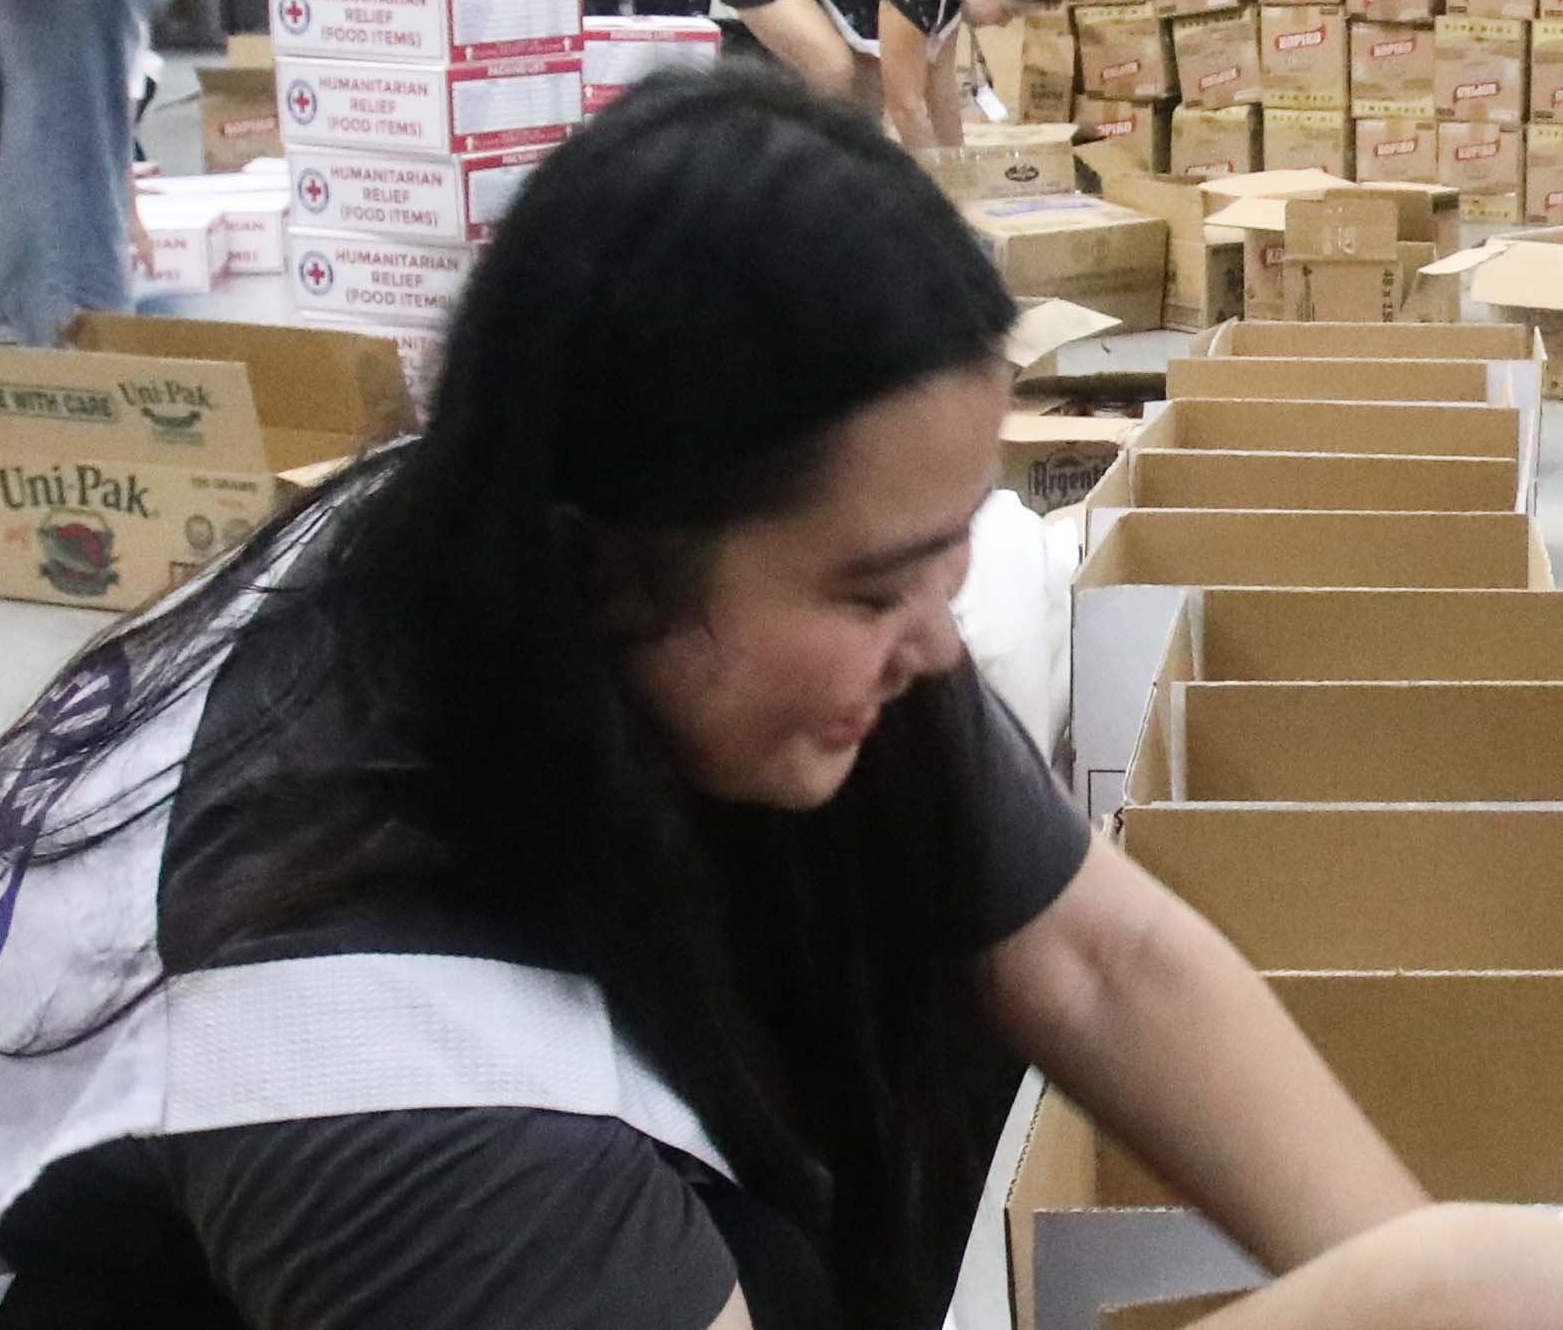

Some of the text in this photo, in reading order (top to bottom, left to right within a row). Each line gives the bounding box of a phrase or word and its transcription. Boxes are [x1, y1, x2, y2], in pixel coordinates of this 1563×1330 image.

[345, 9, 393, 25] RELIEF
[321, 27, 422, 48] (FOOD ITEMS)
[318, 77, 429, 97] HUMANITARIAN
[349, 98, 398, 115] RELIEF
[329, 167, 442, 188] HUMANITARIAN
[362, 188, 410, 204] RELIEF
[334, 250, 460, 271] HUMANITARIAN
[371, 271, 424, 287] RELIEF
[13, 390, 59, 412] WITH
[62, 392, 114, 419] CARE
